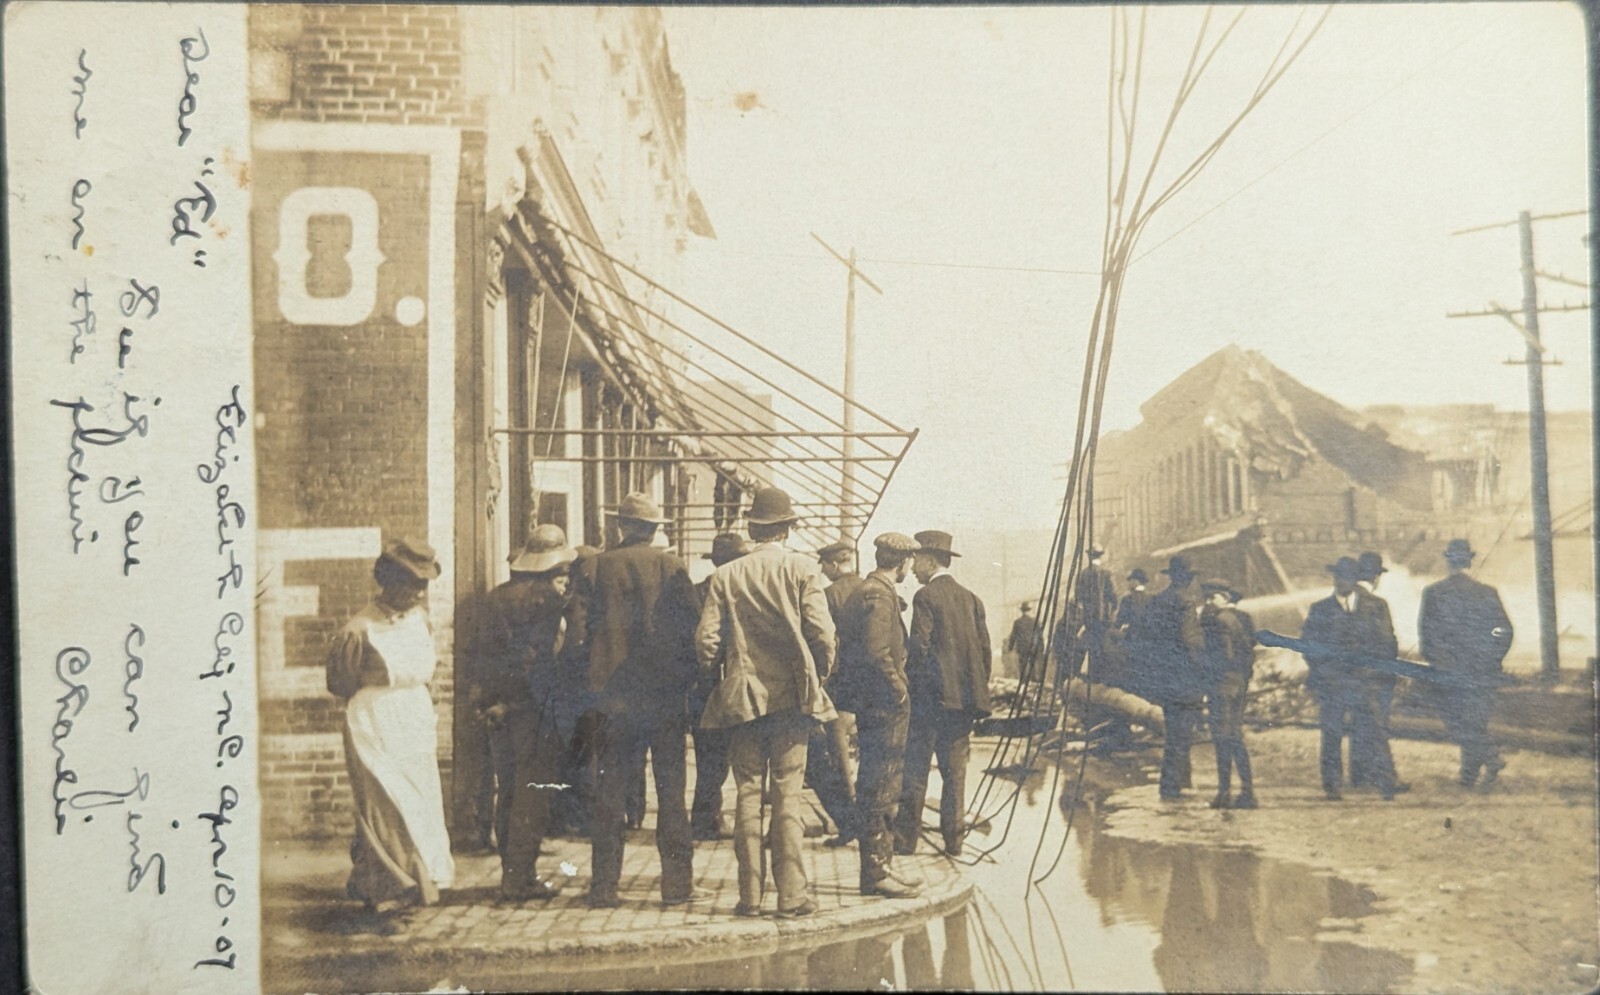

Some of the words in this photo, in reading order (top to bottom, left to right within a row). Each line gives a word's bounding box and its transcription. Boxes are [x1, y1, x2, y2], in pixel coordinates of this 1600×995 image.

[71, 48, 93, 140] me
[178, 26, 210, 148] Dear
[71, 178, 93, 251] on
[70, 278, 97, 365] the
[119, 278, 161, 370] See
[80, 391, 163, 446] if
[99, 475, 145, 577] you
[122, 622, 146, 733] can
[69, 767, 180, 896] find
